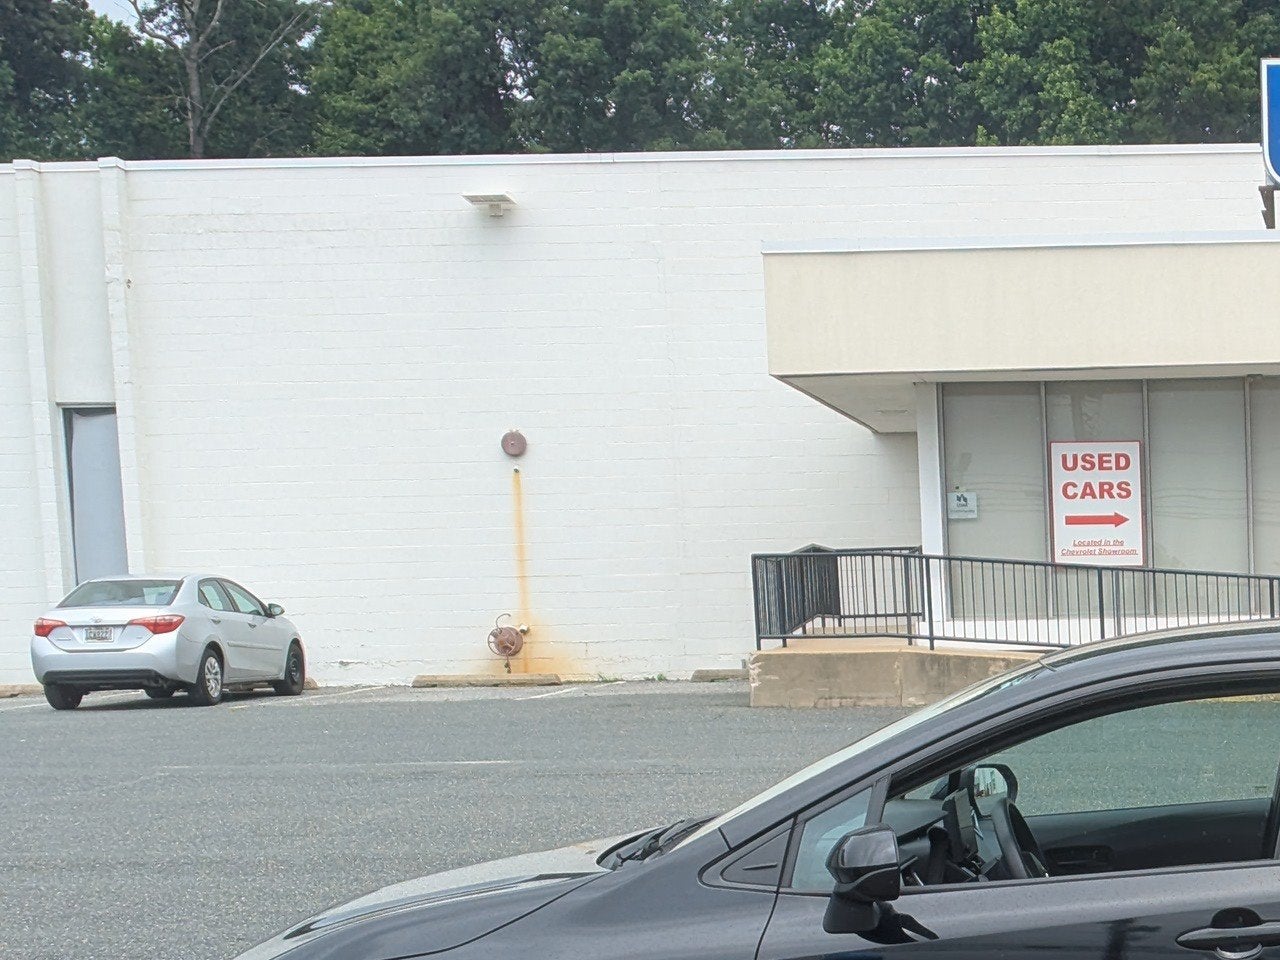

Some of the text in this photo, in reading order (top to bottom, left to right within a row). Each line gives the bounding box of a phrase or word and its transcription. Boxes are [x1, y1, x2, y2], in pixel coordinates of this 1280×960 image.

[1061, 452, 1131, 472] USED
[1061, 481, 1132, 500] CARS
[1073, 539, 1102, 547] Located
[1112, 539, 1125, 547] the
[1060, 548, 1097, 556] Chevrolet
